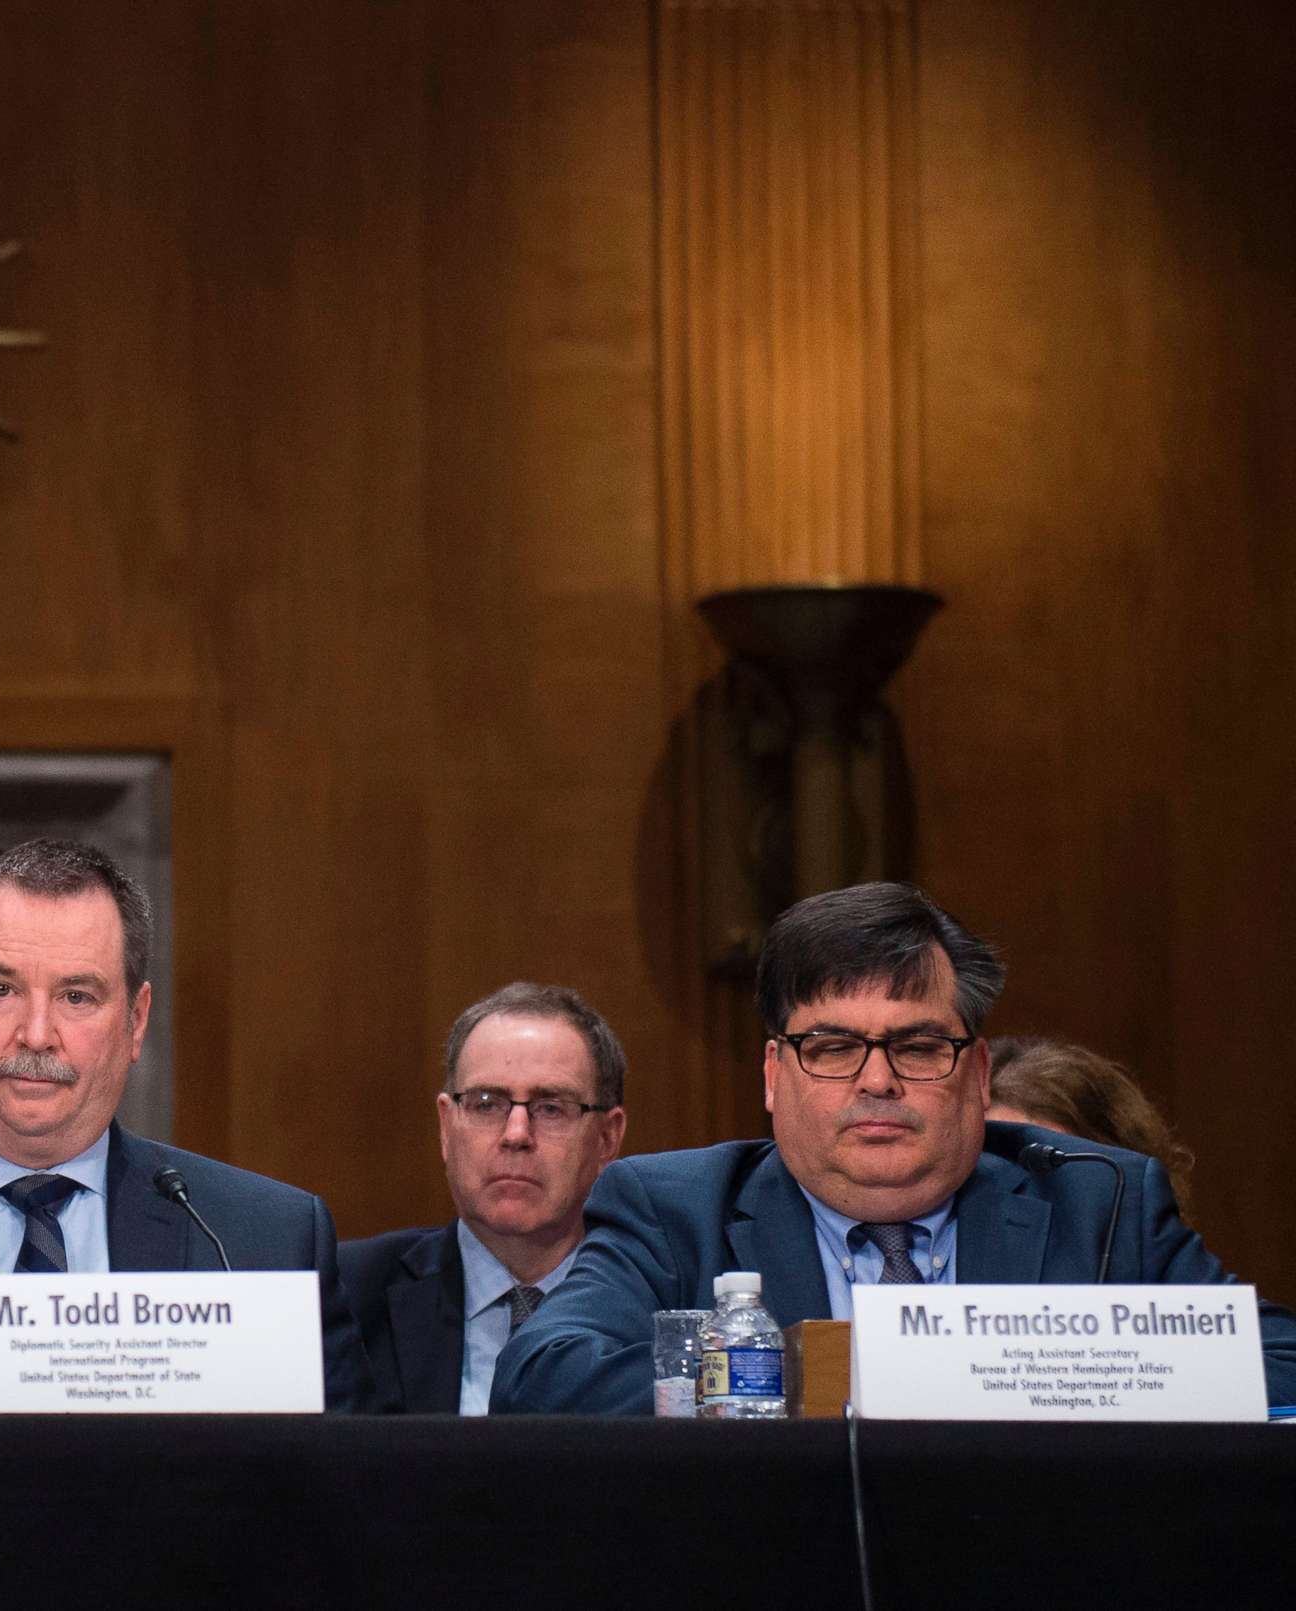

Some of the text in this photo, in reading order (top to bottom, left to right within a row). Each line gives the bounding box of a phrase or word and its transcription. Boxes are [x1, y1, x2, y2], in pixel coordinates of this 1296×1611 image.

[48, 1292, 120, 1326] Todd
[133, 1294, 232, 1325] Brown
[900, 1301, 1237, 1336] Mr. Francisco Palmieri
[10, 1337, 207, 1353] Diplomatic Security Assistant Director
[49, 1354, 170, 1369] International Programs
[1002, 1347, 1140, 1362] Acting Assistant Secretary
[20, 1370, 201, 1384] United States Department of State
[970, 1362, 1174, 1377] Bureau of Western Hemisphere Affairs
[982, 1377, 1164, 1393] United States Department of State
[66, 1386, 155, 1402] Washington, D.C.
[1029, 1394, 1120, 1410] Washington, D.C.
